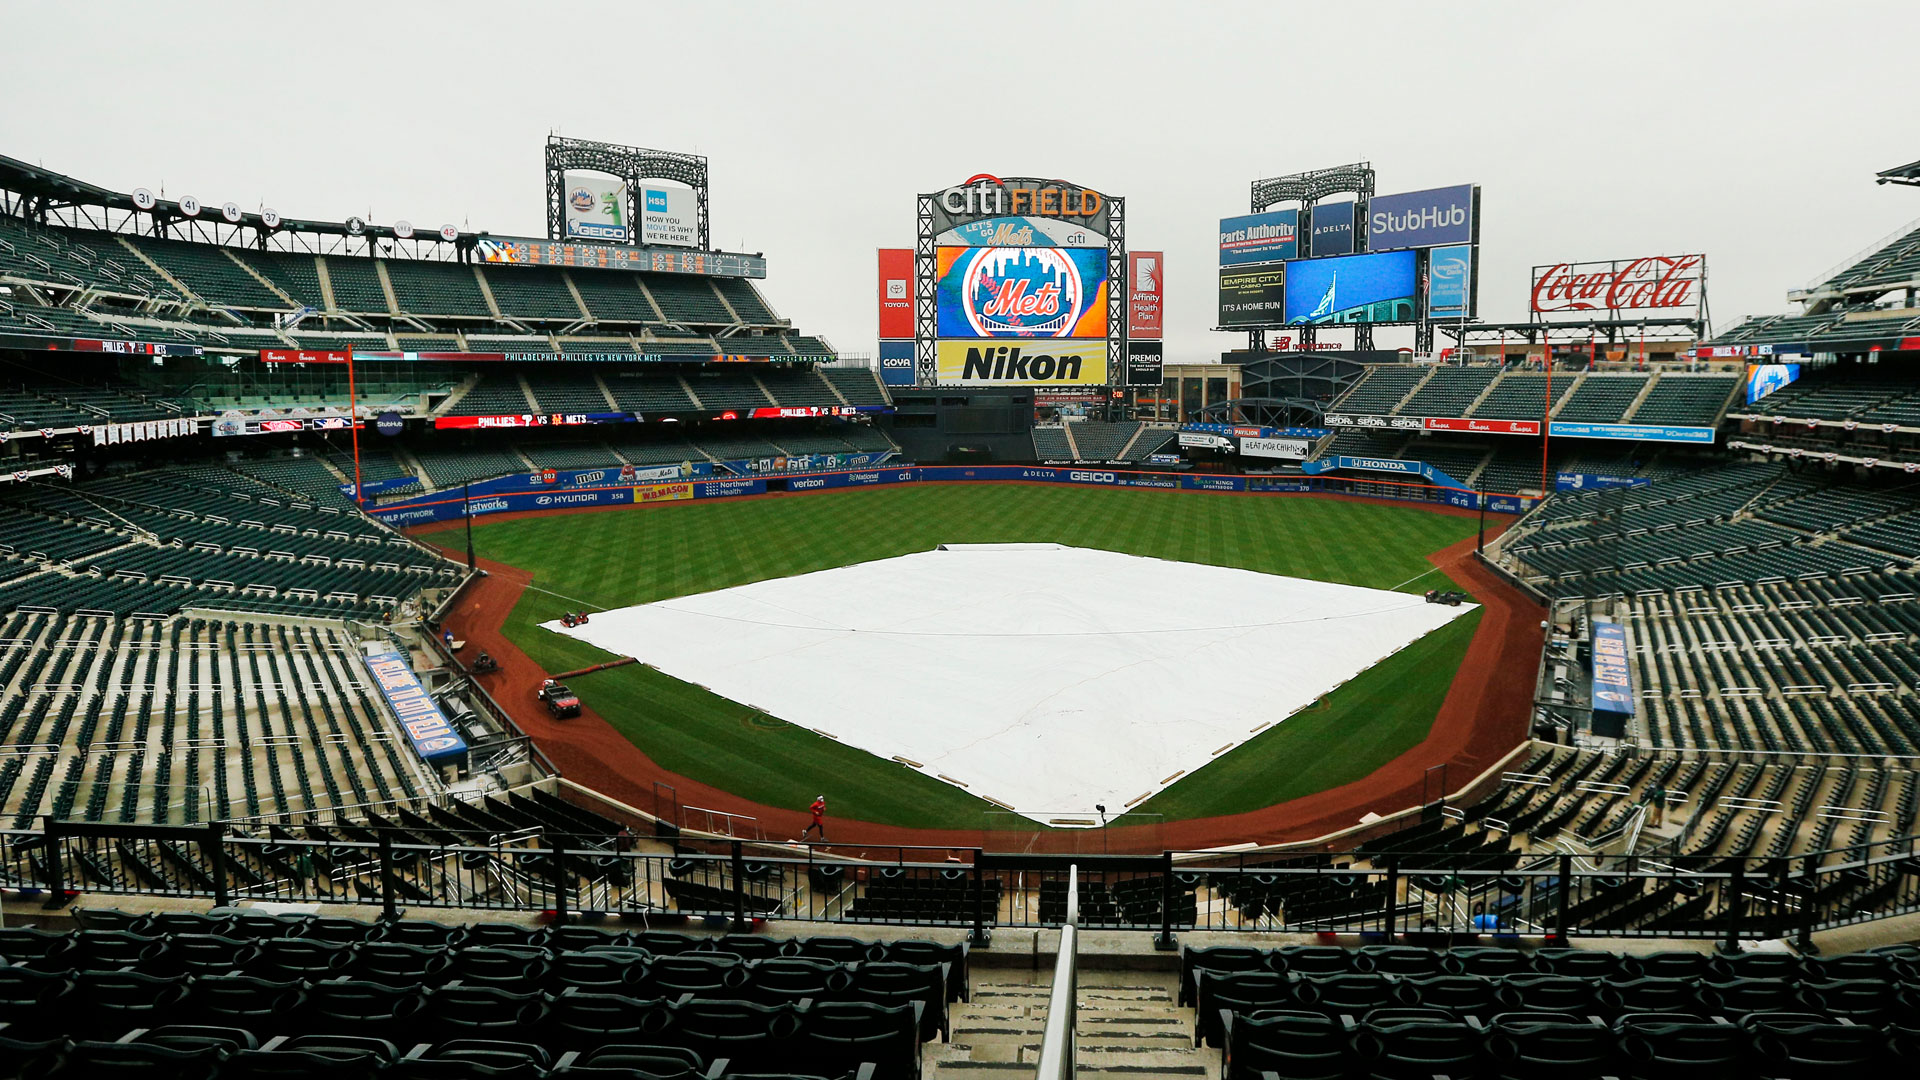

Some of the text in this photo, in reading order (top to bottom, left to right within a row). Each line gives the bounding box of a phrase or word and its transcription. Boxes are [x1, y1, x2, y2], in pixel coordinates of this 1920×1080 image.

[139, 193, 150, 204] 31
[648, 197, 666, 206] HSS
[942, 180, 1101, 216] citi FIELD
[185, 201, 195, 210] 41
[228, 207, 236, 216] 14
[266, 213, 275, 222] 37
[646, 216, 680, 224] HOW YOU
[1372, 204, 1465, 234] StubHub
[678, 226, 694, 234] WHY
[965, 220, 992, 232] LET'S
[1323, 224, 1351, 233] DELTA
[444, 228, 455, 236] 42
[579, 225, 625, 238] GEICO
[981, 223, 1034, 246] GO Mets
[1220, 223, 1295, 243] Parts Authority
[646, 232, 691, 242] WE'RE HERE.
[1067, 233, 1086, 244] citi
[1224, 275, 1279, 285] EMPIRE CITY
[1531, 254, 1701, 312] Coca-Cola
[983, 278, 1061, 316] Mets
[1132, 293, 1160, 303] Affinity
[1134, 303, 1158, 312] Health
[1222, 304, 1235, 312] IT'S
[1242, 302, 1264, 310] HOME
[1264, 302, 1280, 310] RUN
[1138, 312, 1154, 320] Plan
[102, 342, 125, 353] PHILLIES
[1310, 342, 1342, 350] balance
[504, 353, 558, 361] PHILADELPHIA
[560, 353, 593, 361] PHILLIES
[608, 354, 622, 362] NEW
[624, 354, 642, 362] YORK
[644, 354, 662, 362] METS
[883, 358, 911, 366] GOYA
[1130, 354, 1161, 362] PREMIO
[962, 346, 1082, 380] Nikon
[780, 408, 806, 417] PHILLIES
[841, 407, 856, 415] METS
[478, 414, 587, 428] PHILLIES VS METS
[218, 423, 240, 431] Coors
[1234, 428, 1260, 436] PAVILION
[1246, 441, 1261, 449] #EAT
[1262, 442, 1275, 450] MOR
[1362, 460, 1407, 470] HONDA
[530, 473, 542, 481] citi
[856, 472, 879, 480] National
[898, 472, 911, 480] citi
[1070, 472, 1114, 482] GEICO
[720, 480, 753, 488] Northwell
[794, 478, 824, 488] verizon
[720, 488, 742, 496] Health
[554, 494, 598, 503] HYUNDAI
[1492, 502, 1515, 511] Corona
[400, 509, 434, 520] NETWORK
[1596, 664, 1628, 686] LET'S
[371, 660, 451, 740] WELCOME TO CITI FIELD
